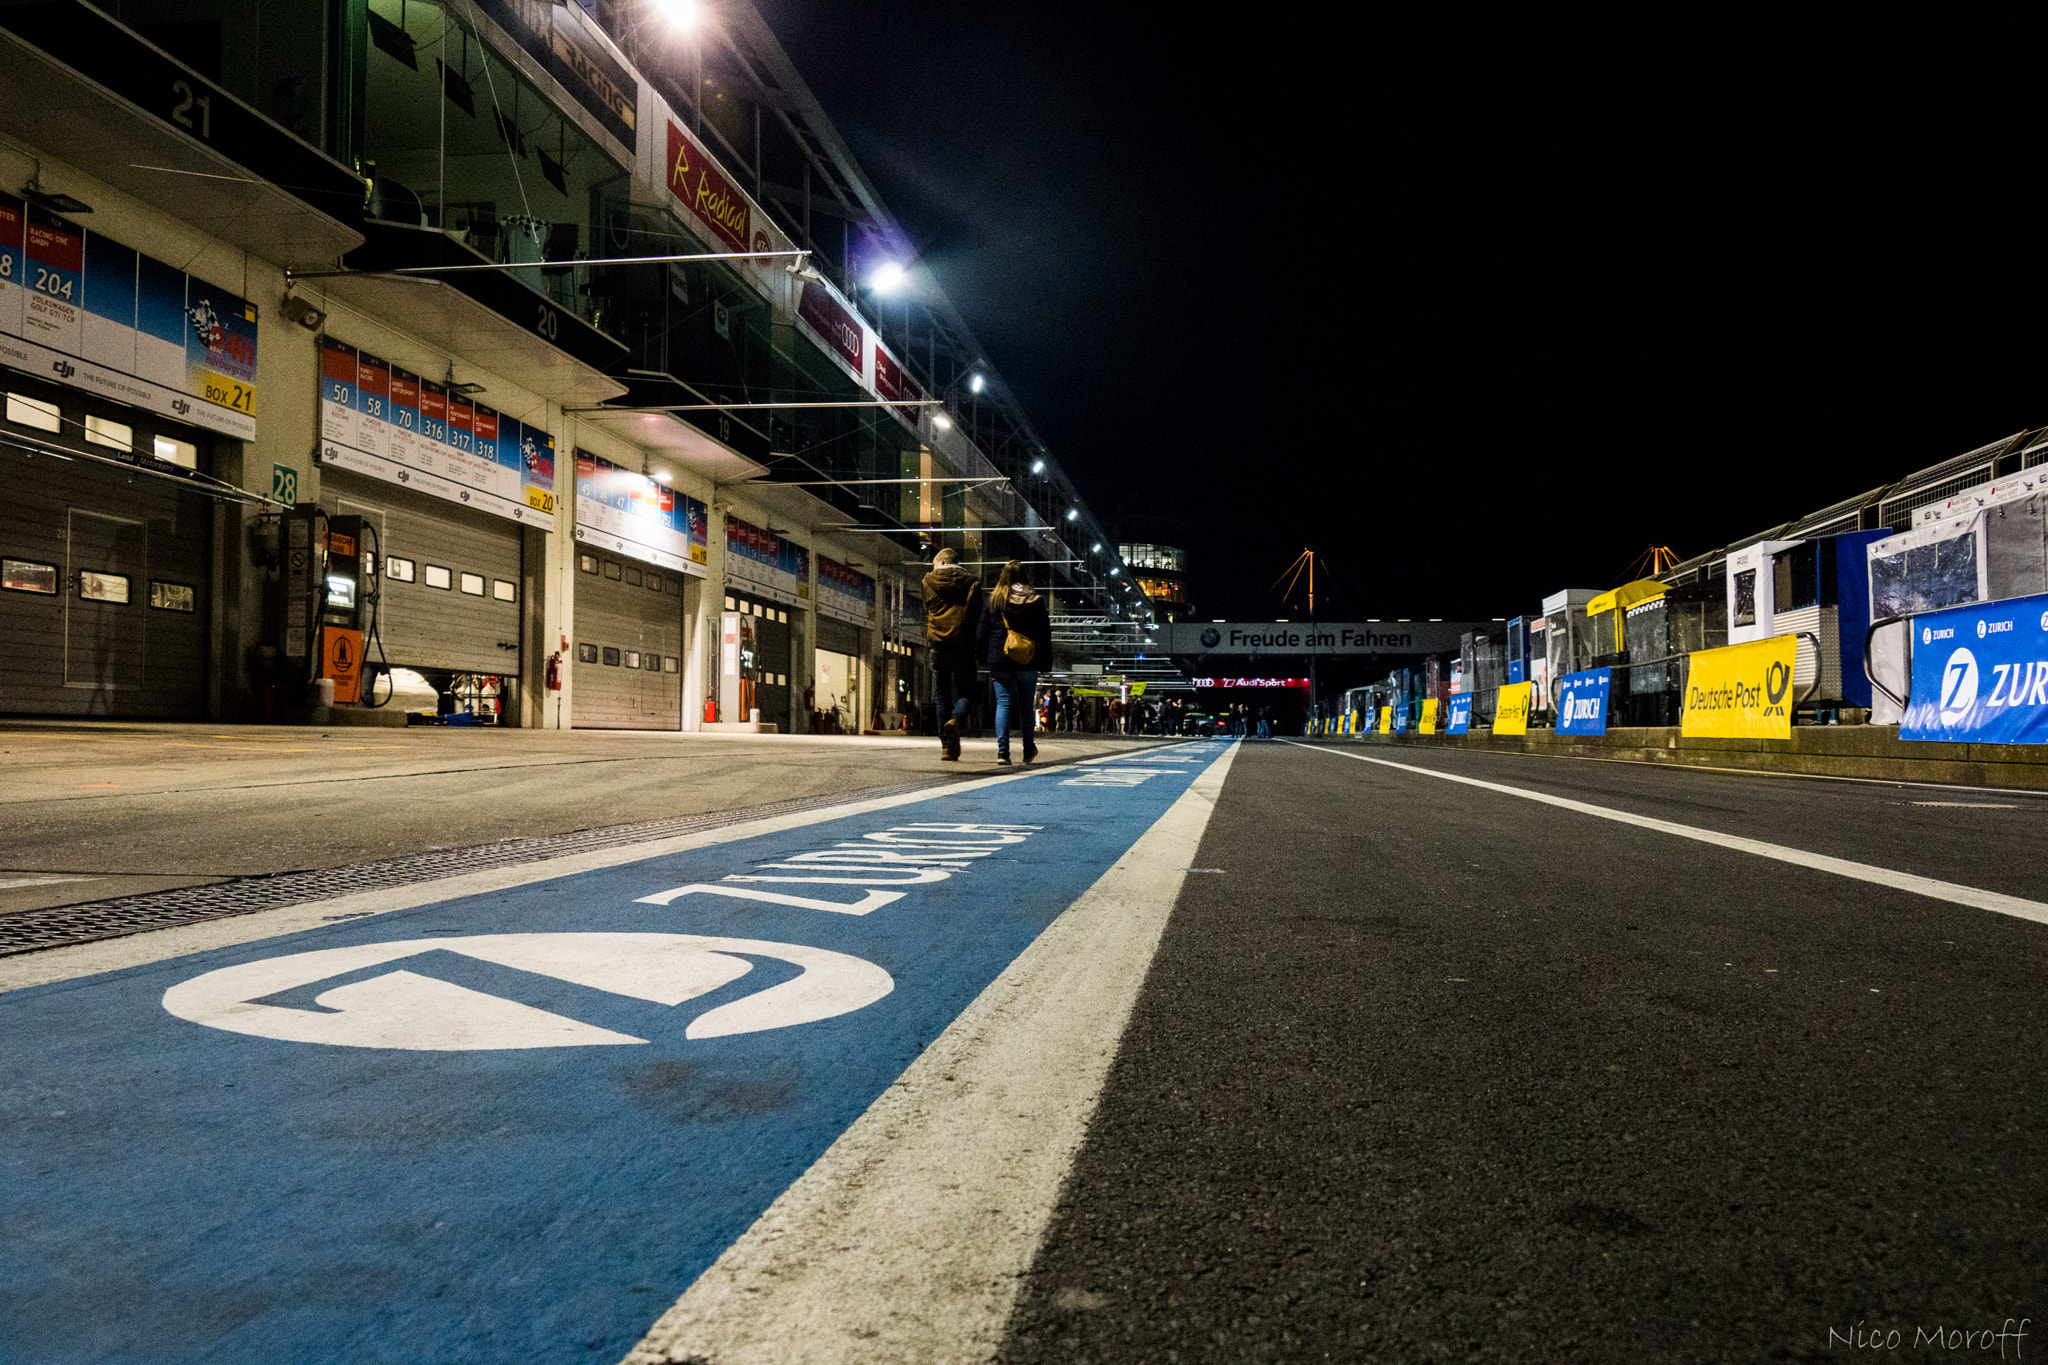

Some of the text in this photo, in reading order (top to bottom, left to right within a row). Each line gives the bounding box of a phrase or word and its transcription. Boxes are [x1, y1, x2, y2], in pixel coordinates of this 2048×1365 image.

[172, 80, 210, 138] 21
[696, 168, 747, 239] Radical
[30, 227, 68, 245] RACING ONE
[35, 268, 73, 300] 204
[31, 303, 48, 313] GOLF
[50, 309, 61, 319] GTI
[63, 313, 76, 323] TCR
[32, 294, 75, 315] VOLKSWAGEN
[536, 303, 558, 341] 20
[83, 372, 95, 382] THE
[96, 376, 117, 390] FUTURE
[118, 382, 127, 391] OF
[127, 385, 152, 400] POSSIBLE
[334, 385, 348, 403] 50
[205, 385, 252, 411] BOX 21
[367, 397, 381, 416] 58
[399, 410, 412, 428] 70
[718, 415, 730, 441] 19
[424, 420, 443, 440] 316
[452, 430, 470, 449] 317
[478, 441, 494, 459] 318
[274, 469, 297, 505] 28
[530, 494, 553, 511] BOX 20
[617, 496, 625, 509] 47
[1932, 628, 1955, 640] ZURICH
[1988, 620, 2013, 633] ZURICH
[1230, 629, 1411, 647] Freude am Fahren
[1236, 678, 1286, 688] Audi Sport
[1690, 682, 1761, 710] Deutsche Post
[1573, 698, 1600, 719] ZURICH
[633, 821, 1046, 916] ZURICH
